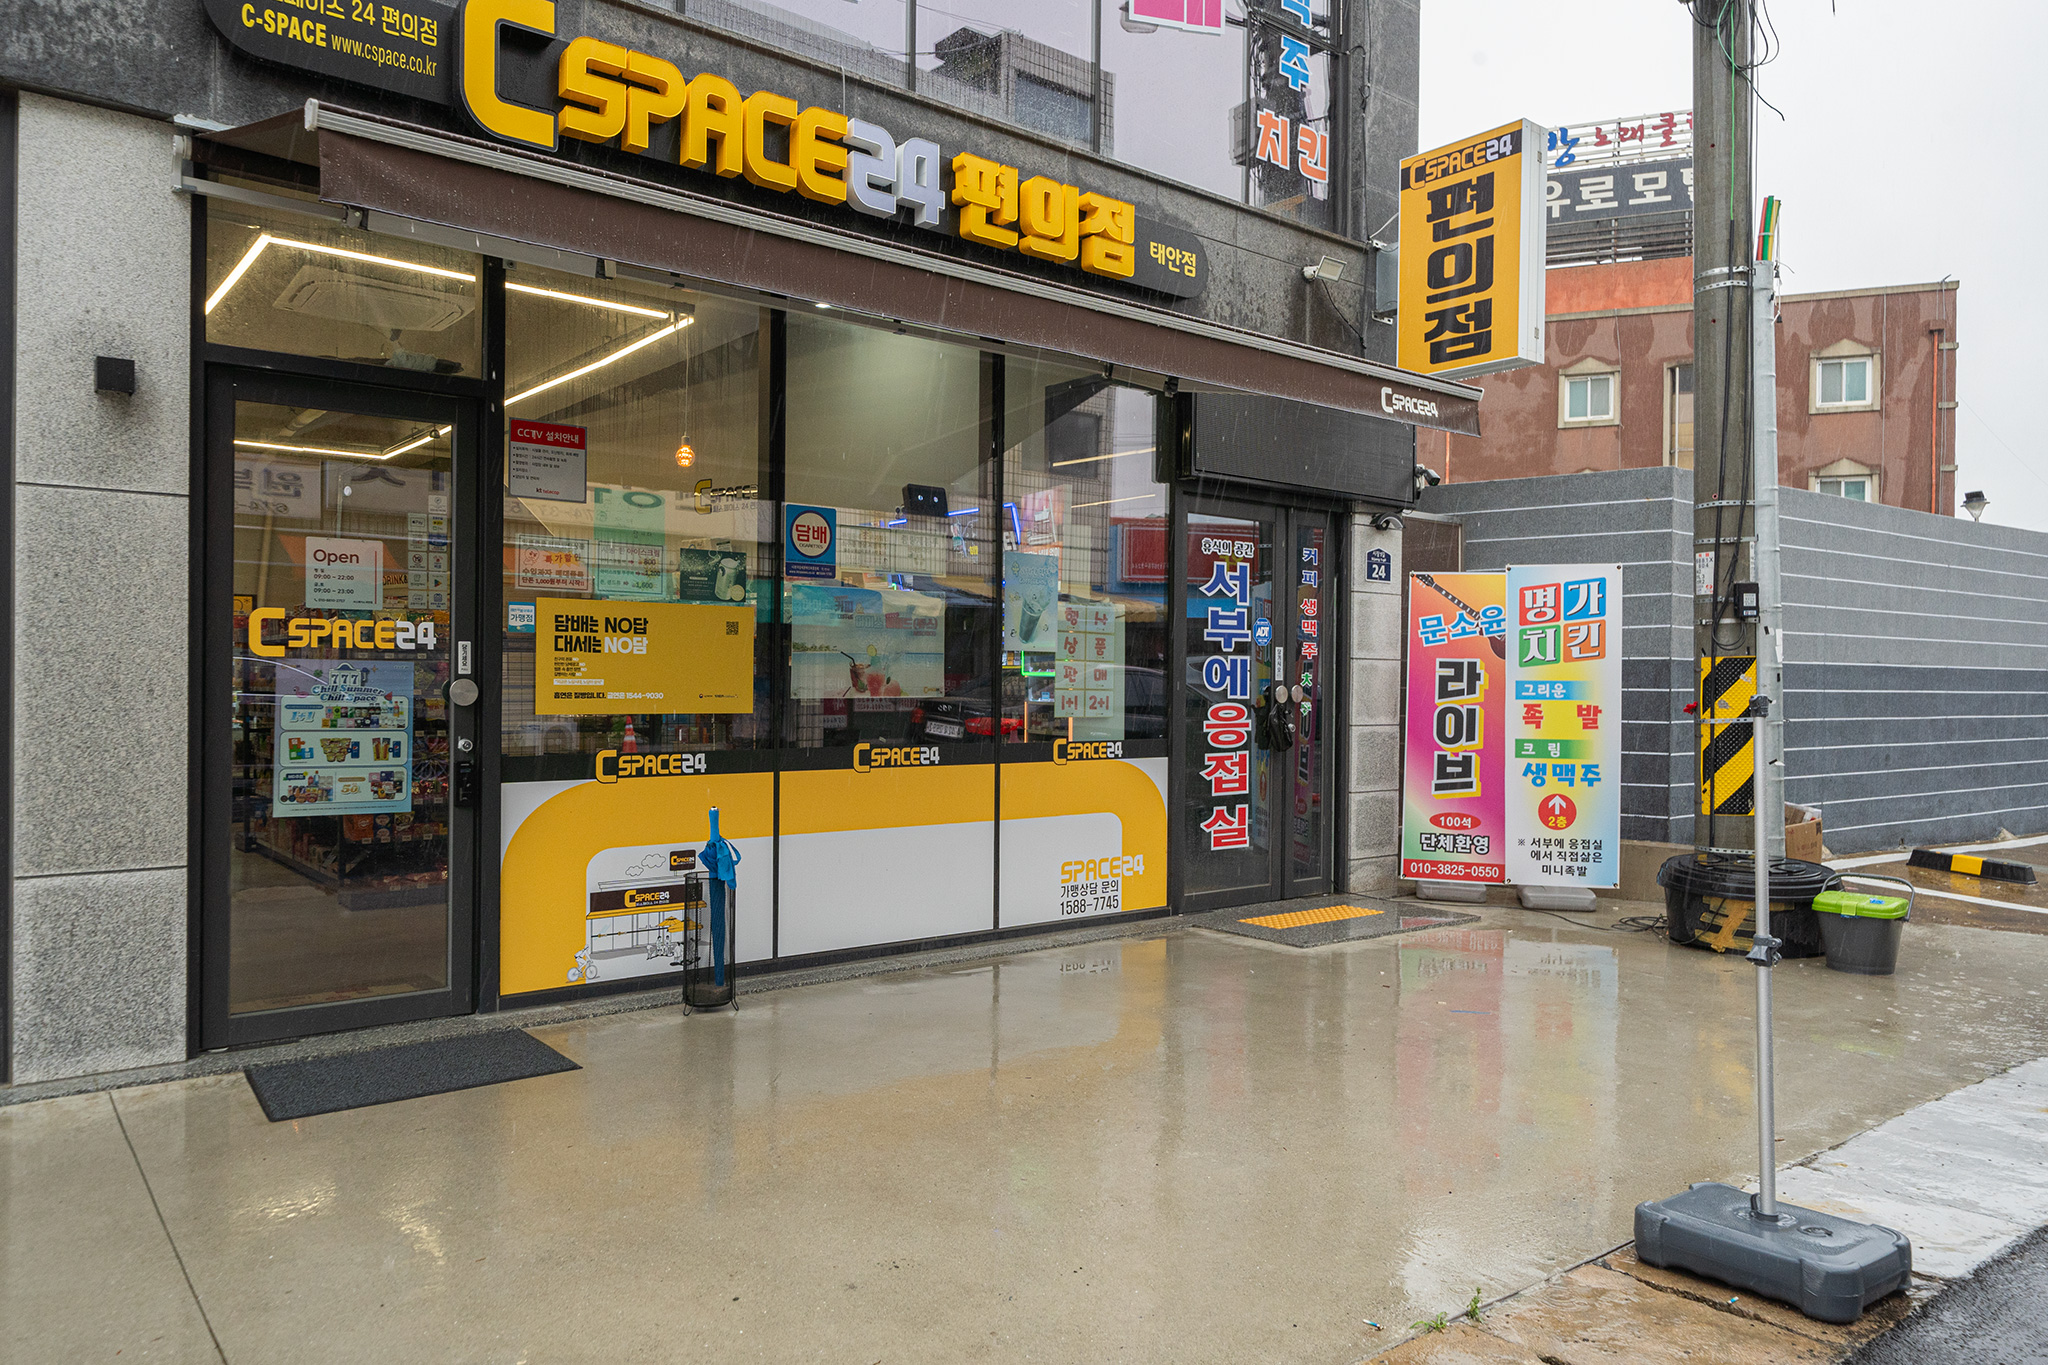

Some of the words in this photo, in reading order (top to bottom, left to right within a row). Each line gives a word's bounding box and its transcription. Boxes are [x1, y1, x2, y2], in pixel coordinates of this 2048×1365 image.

[351, 0, 376, 26] 24
[382, 5, 438, 47] 편의점
[241, 3, 327, 48] C-SPACE
[331, 34, 438, 77] www.cspace.co.kr
[1593, 111, 1693, 148] 노래클
[1255, 107, 1330, 184] 치킨
[1409, 134, 1513, 191] CSPACE24
[952, 151, 1136, 280] 편의점
[1149, 240, 1197, 278] 태안점
[1424, 171, 1495, 365] 편의점
[1381, 386, 1438, 418] CSPACE24
[517, 428, 543, 440] CCTV
[545, 431, 579, 444] 설치안내
[795, 524, 827, 544] 담배
[313, 548, 360, 566] Open
[1201, 538, 1232, 556] 휴식의
[1233, 540, 1255, 558] 공간
[1302, 547, 1318, 588] 커피
[1371, 563, 1386, 579] 24
[510, 613, 533, 622] 가맹점
[554, 614, 599, 633] 담배는
[1418, 604, 1507, 648] 문소윤
[248, 607, 437, 658] CSPACE24
[1199, 560, 1252, 700] 서부에
[1255, 625, 1270, 638] ADT
[1300, 598, 1318, 660] 생맥주
[554, 635, 602, 653] 대세는
[604, 637, 649, 655] NO담
[312, 685, 338, 695] Chill
[339, 684, 385, 697] Summer
[626, 692, 664, 700] 1544-9030
[1521, 683, 1567, 698] 그리운
[1089, 695, 1110, 711] 2+1
[1431, 657, 1488, 800] 라이브
[853, 742, 941, 773] CSPACE24
[1053, 738, 1123, 765] CSPACE24
[596, 750, 707, 784] CSPACE24
[1199, 701, 1252, 851] 응접실
[1522, 762, 1602, 788] 생맥주
[1439, 815, 1472, 829] 100석
[1548, 816, 1567, 828] 2층
[1419, 832, 1490, 855] 단체환영
[1530, 838, 1565, 850] 서부에
[1568, 838, 1603, 851] 응접실
[1530, 850, 1553, 862] 에서
[1556, 851, 1603, 863] 직접삶은
[1060, 854, 1145, 884] SPACE24
[1410, 861, 1499, 879] 010-3825-0550
[1541, 864, 1588, 877] 미니족발
[624, 890, 670, 908] CSPACE24
[1060, 882, 1098, 899] 가맹상담
[1101, 879, 1119, 894] 문의
[1059, 895, 1119, 916] 1588-7745
